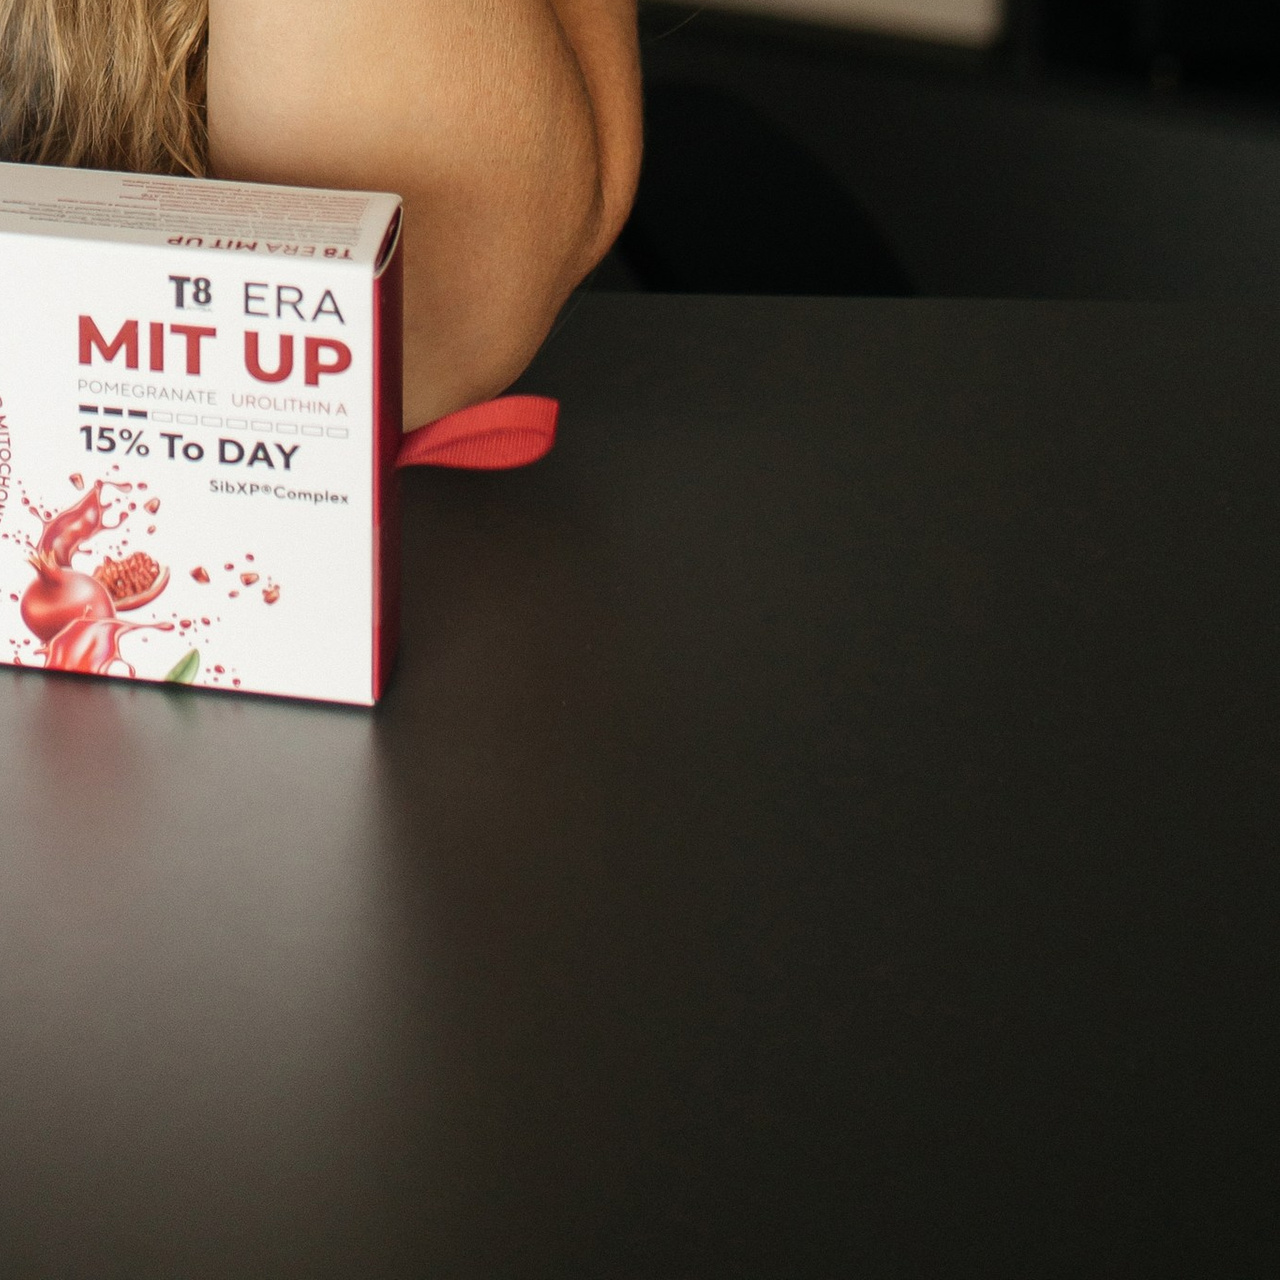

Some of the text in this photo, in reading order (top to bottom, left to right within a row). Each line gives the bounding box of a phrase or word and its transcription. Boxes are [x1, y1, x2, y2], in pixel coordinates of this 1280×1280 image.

[167, 235, 353, 260] T8 ERA MIT UP
[168, 274, 345, 325] T8 ERA
[78, 314, 353, 387] MIT UP
[77, 379, 348, 416] POMEGRANATE UROLITHIN A
[79, 425, 300, 471] 15% To DAY
